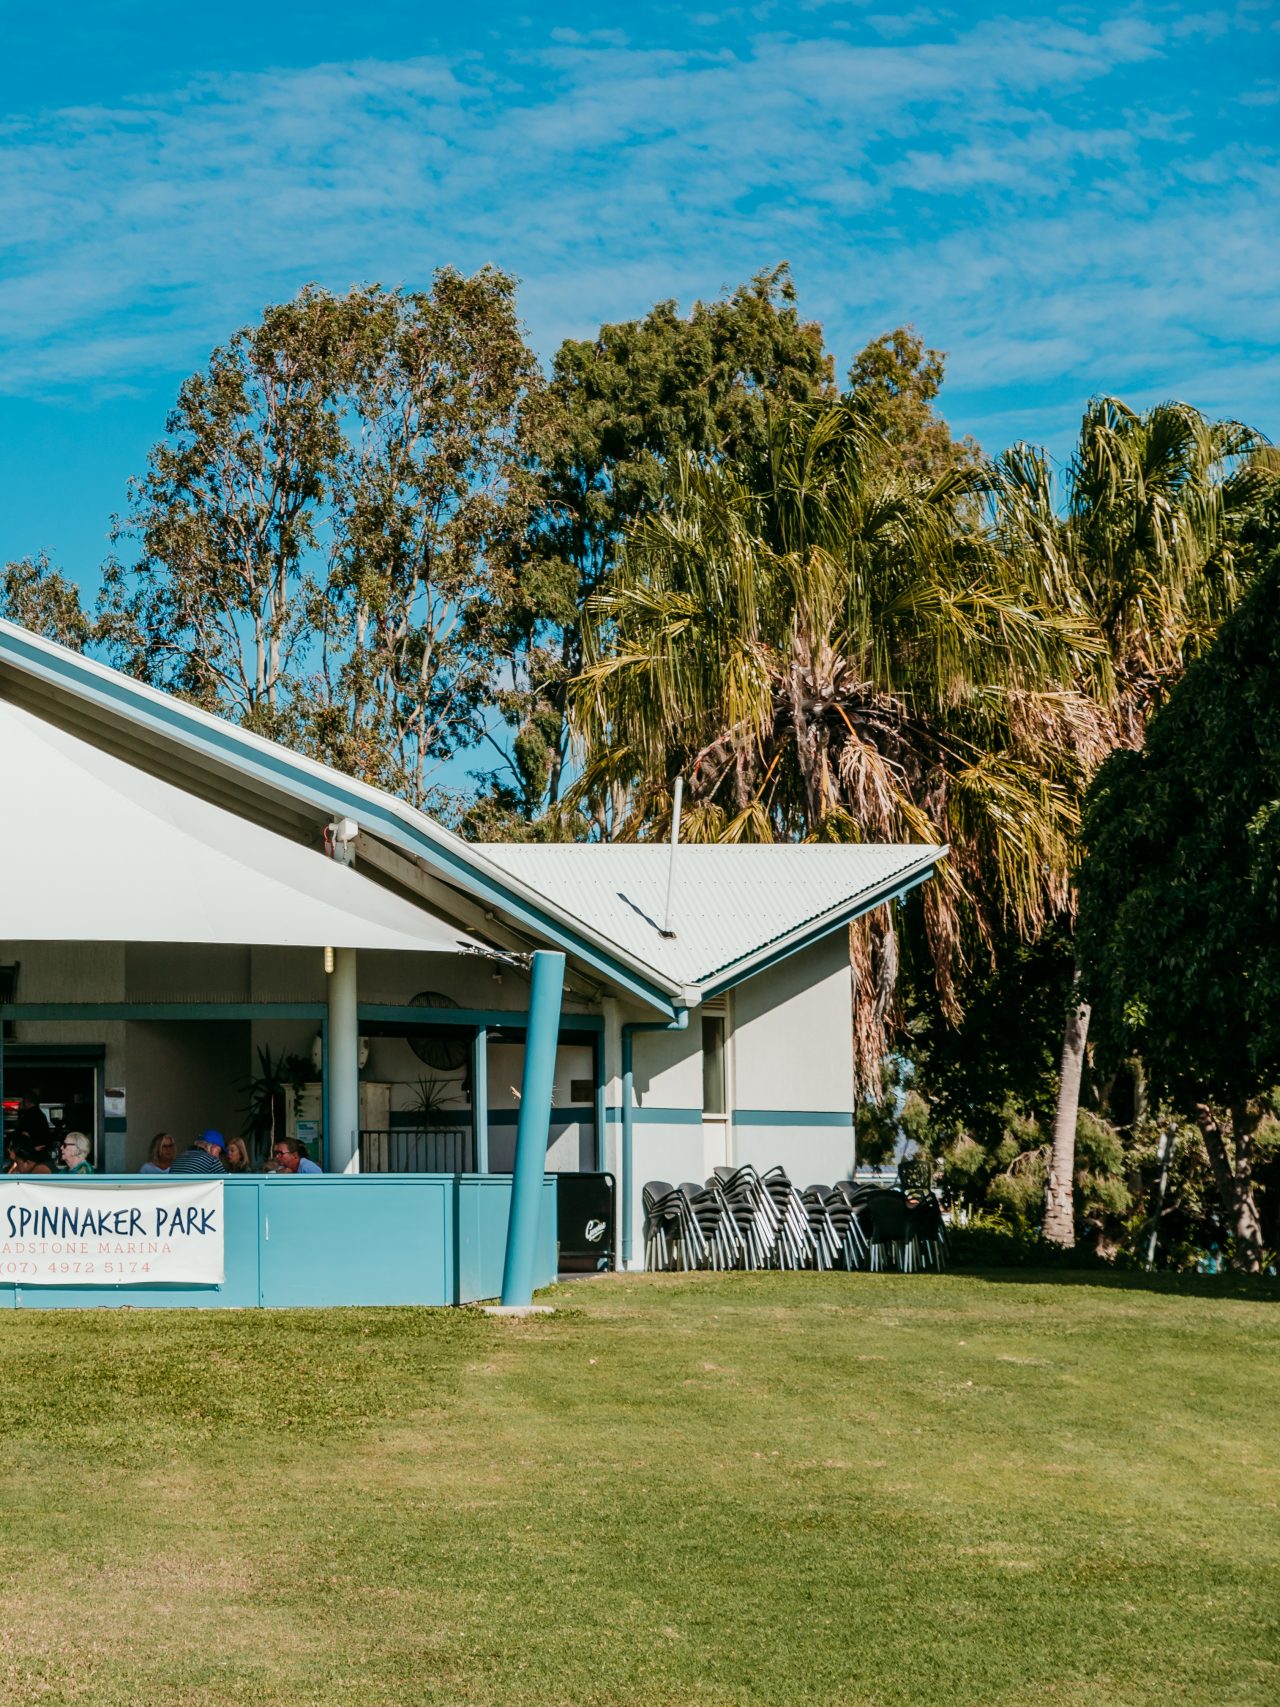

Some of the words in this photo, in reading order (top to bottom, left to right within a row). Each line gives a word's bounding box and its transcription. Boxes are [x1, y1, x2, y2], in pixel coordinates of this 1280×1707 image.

[6, 1205, 147, 1239] SPINNAKER
[156, 1206, 217, 1237] PARK
[98, 1242, 172, 1254] MARINA
[48, 1262, 95, 1273] 4972
[104, 1262, 151, 1273] 5174
